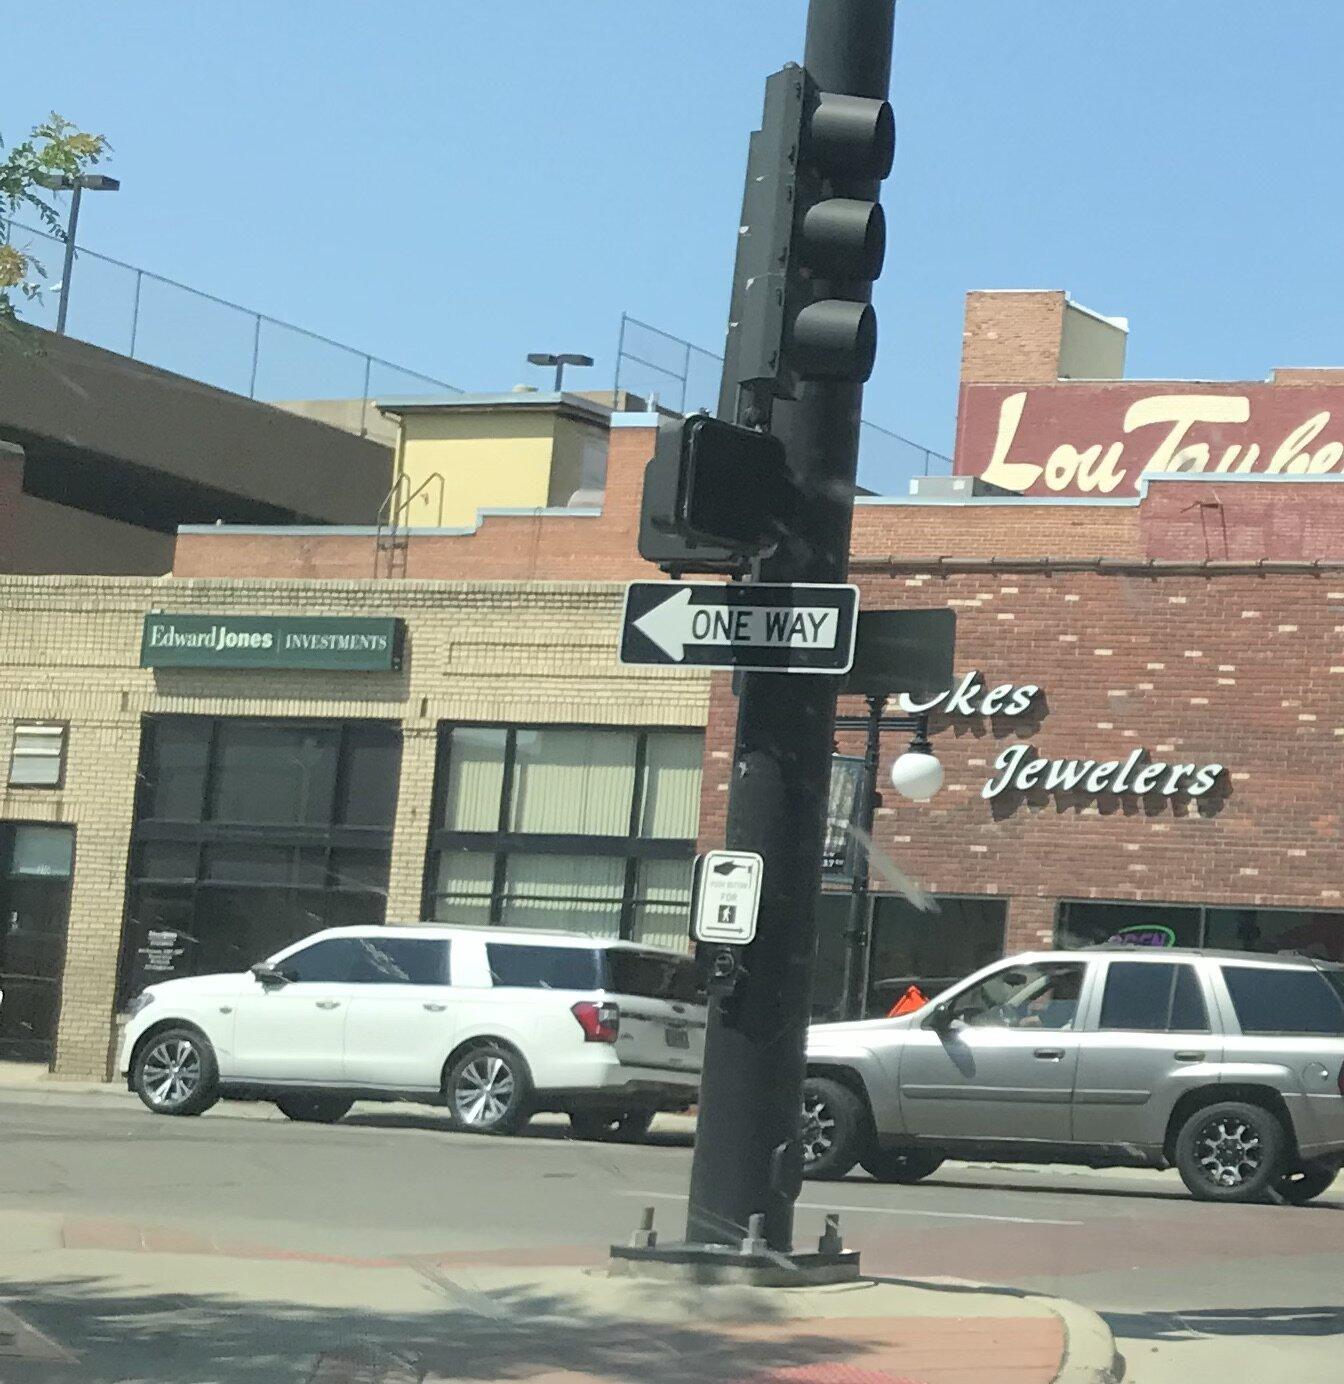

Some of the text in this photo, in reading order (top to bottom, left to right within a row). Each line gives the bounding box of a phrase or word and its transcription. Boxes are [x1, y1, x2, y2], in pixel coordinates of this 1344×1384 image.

[980, 391, 1126, 493] Lou
[285, 633, 388, 651] INVESTMENTS
[691, 609, 830, 644] ONE WAY
[899, 670, 1040, 715] kes
[981, 744, 1224, 800] Jewelers
